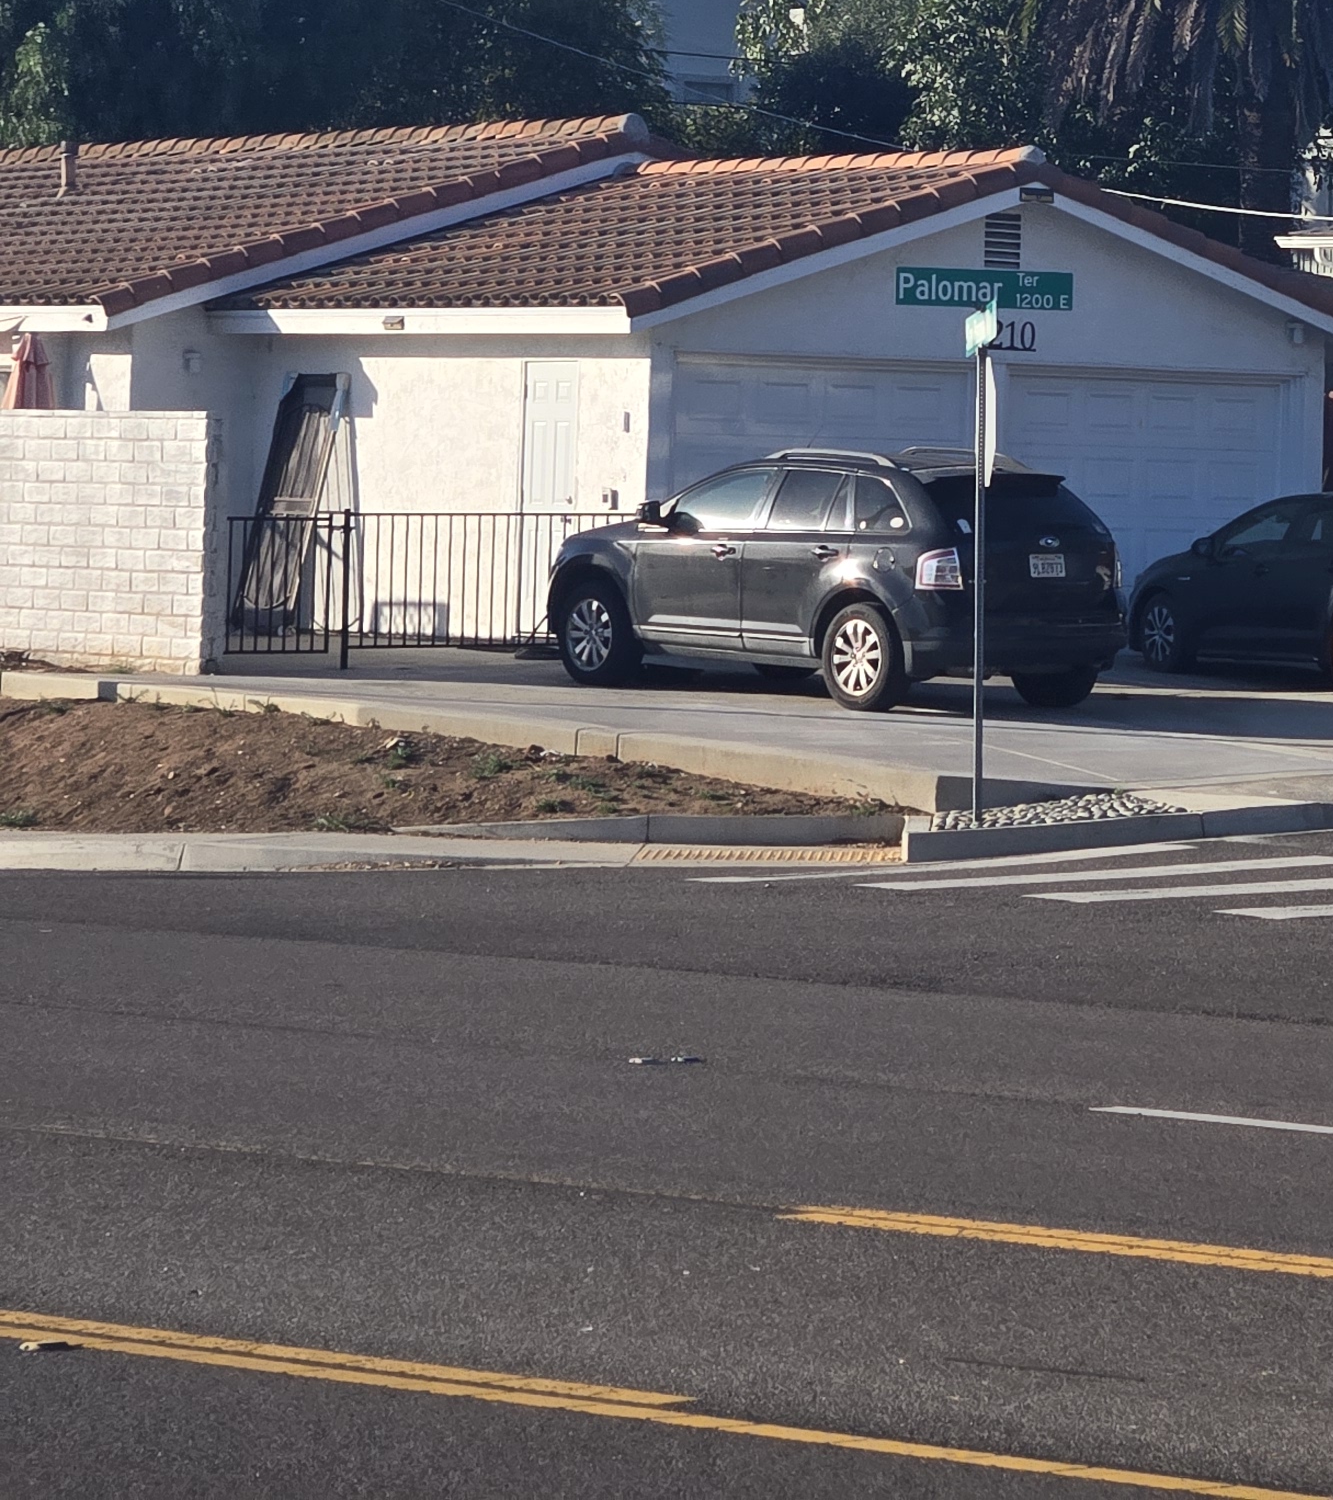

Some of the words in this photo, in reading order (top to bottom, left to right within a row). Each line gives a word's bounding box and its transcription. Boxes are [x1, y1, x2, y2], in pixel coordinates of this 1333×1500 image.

[898, 272, 1003, 302] Palomar
[1016, 272, 1040, 287] Ter
[1015, 293, 1053, 309] 1200
[1059, 294, 1069, 309] E
